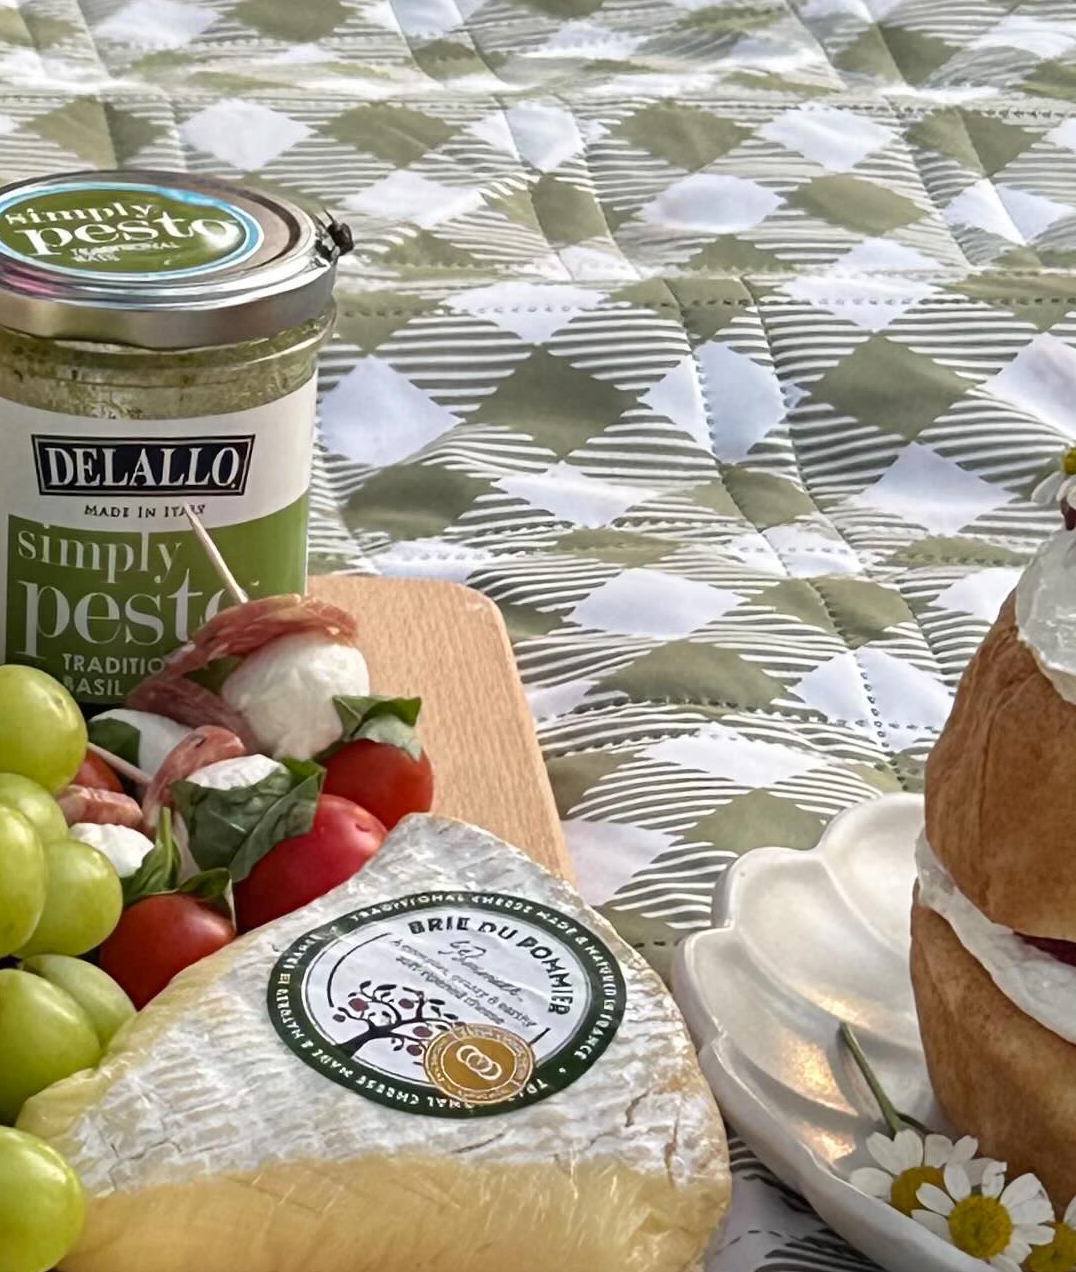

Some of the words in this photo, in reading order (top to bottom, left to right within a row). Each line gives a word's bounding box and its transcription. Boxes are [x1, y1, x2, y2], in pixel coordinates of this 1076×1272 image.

[5, 202, 153, 226] simply
[14, 210, 238, 257] pesto
[44, 446, 236, 489] DELALLO
[84, 504, 129, 518] MADE
[137, 505, 156, 518] IN
[18, 525, 182, 584] simply
[17, 568, 225, 660] pest
[62, 653, 165, 675] TRADITIO
[408, 916, 471, 935] BRIE
[478, 922, 518, 940] DU
[516, 936, 574, 1015] POMMIER
